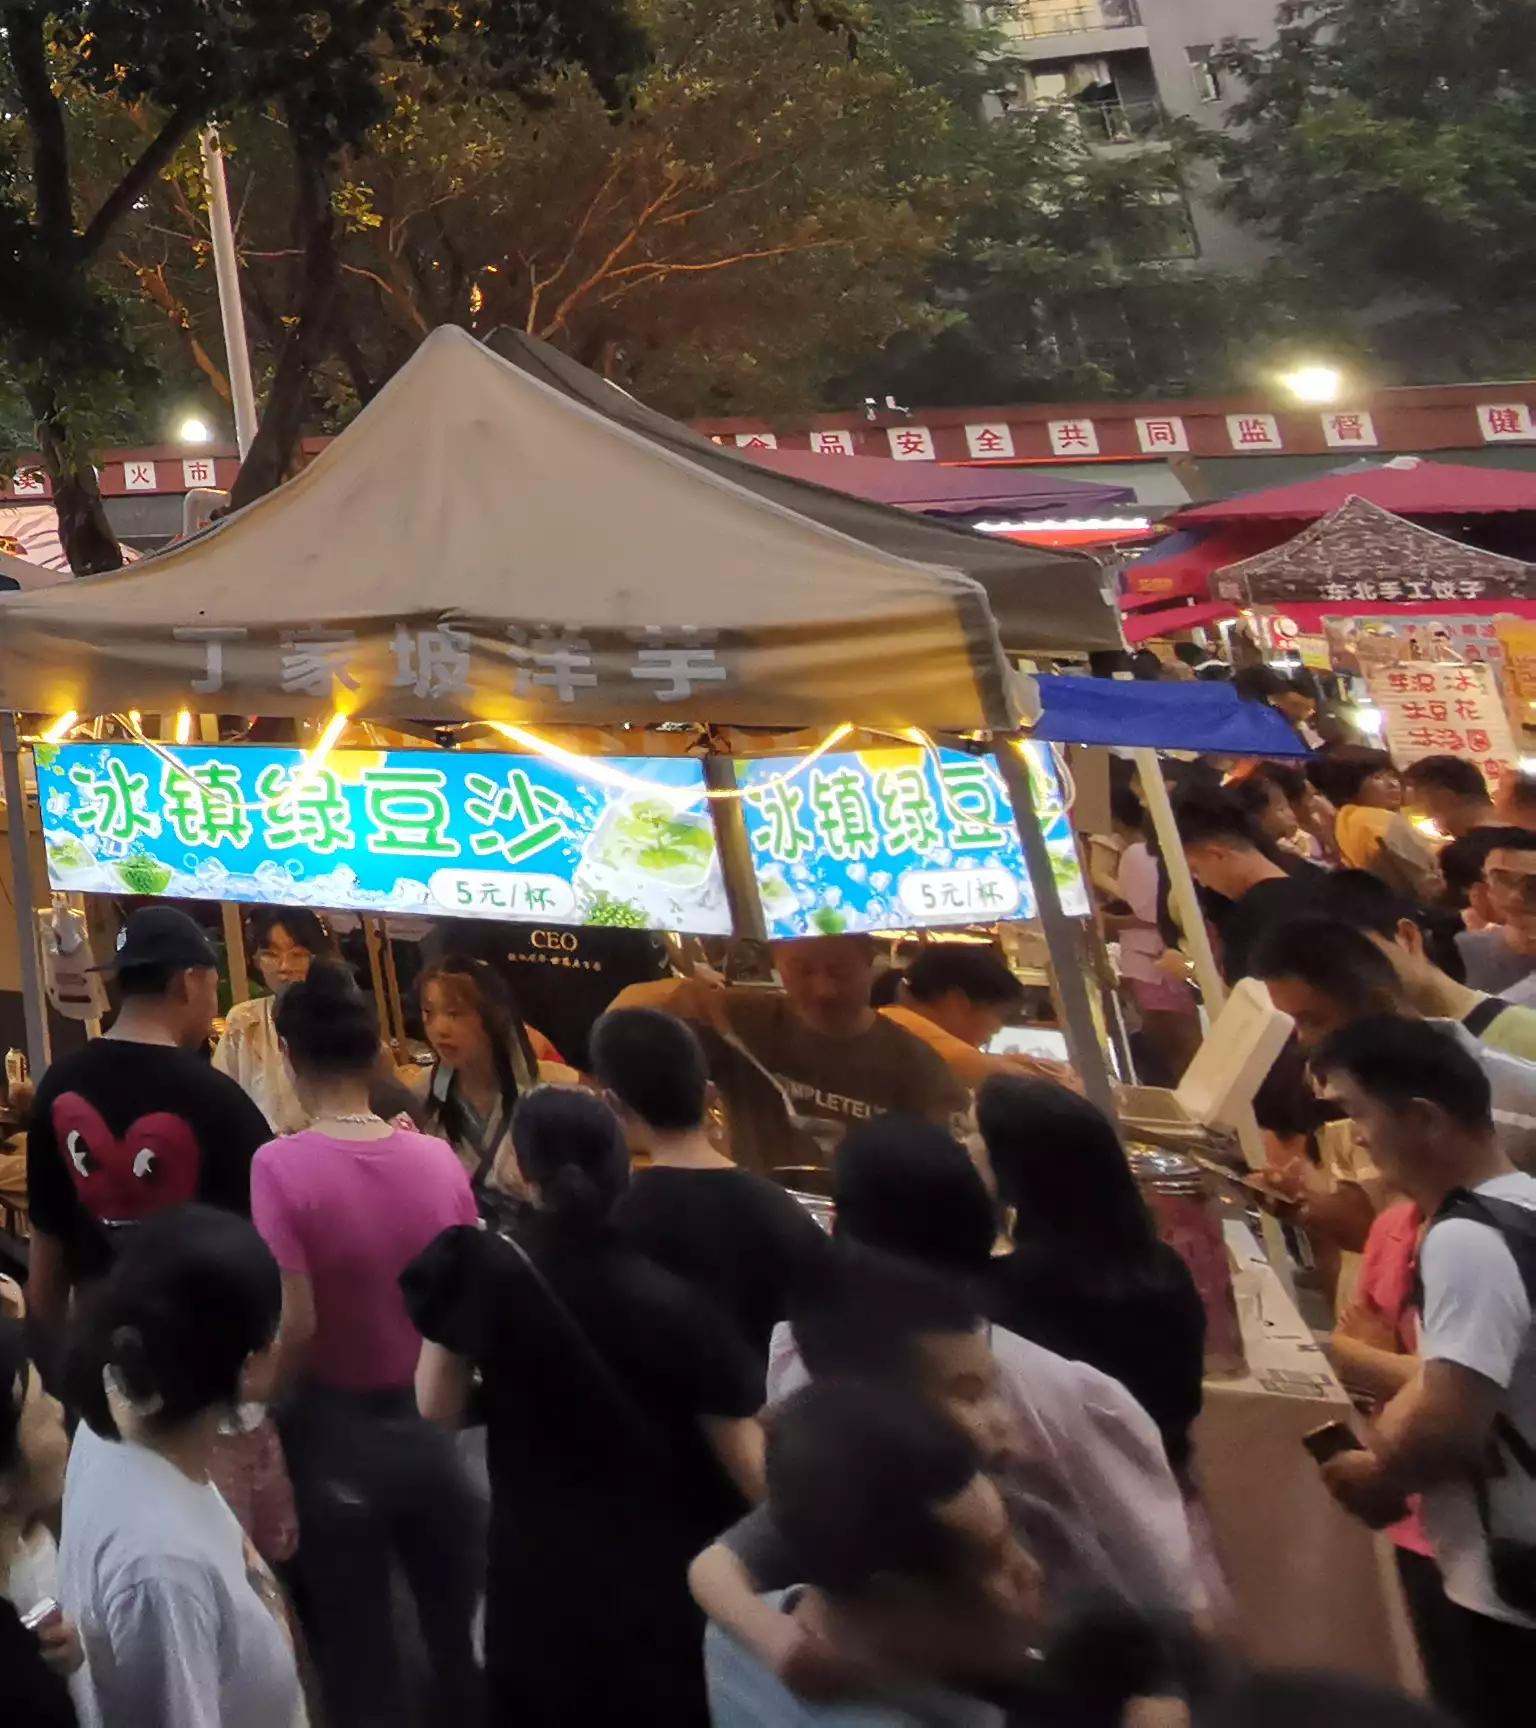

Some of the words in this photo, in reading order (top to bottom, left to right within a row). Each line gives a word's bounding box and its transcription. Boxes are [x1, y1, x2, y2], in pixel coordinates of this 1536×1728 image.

[70, 759, 566, 864] 冰镇绿豆沙
[747, 762, 1066, 863] 冰镇绿豆
[456, 878, 559, 912] 5元/杯
[921, 877, 1006, 909] 5元/杯
[530, 929, 578, 952] CEO
